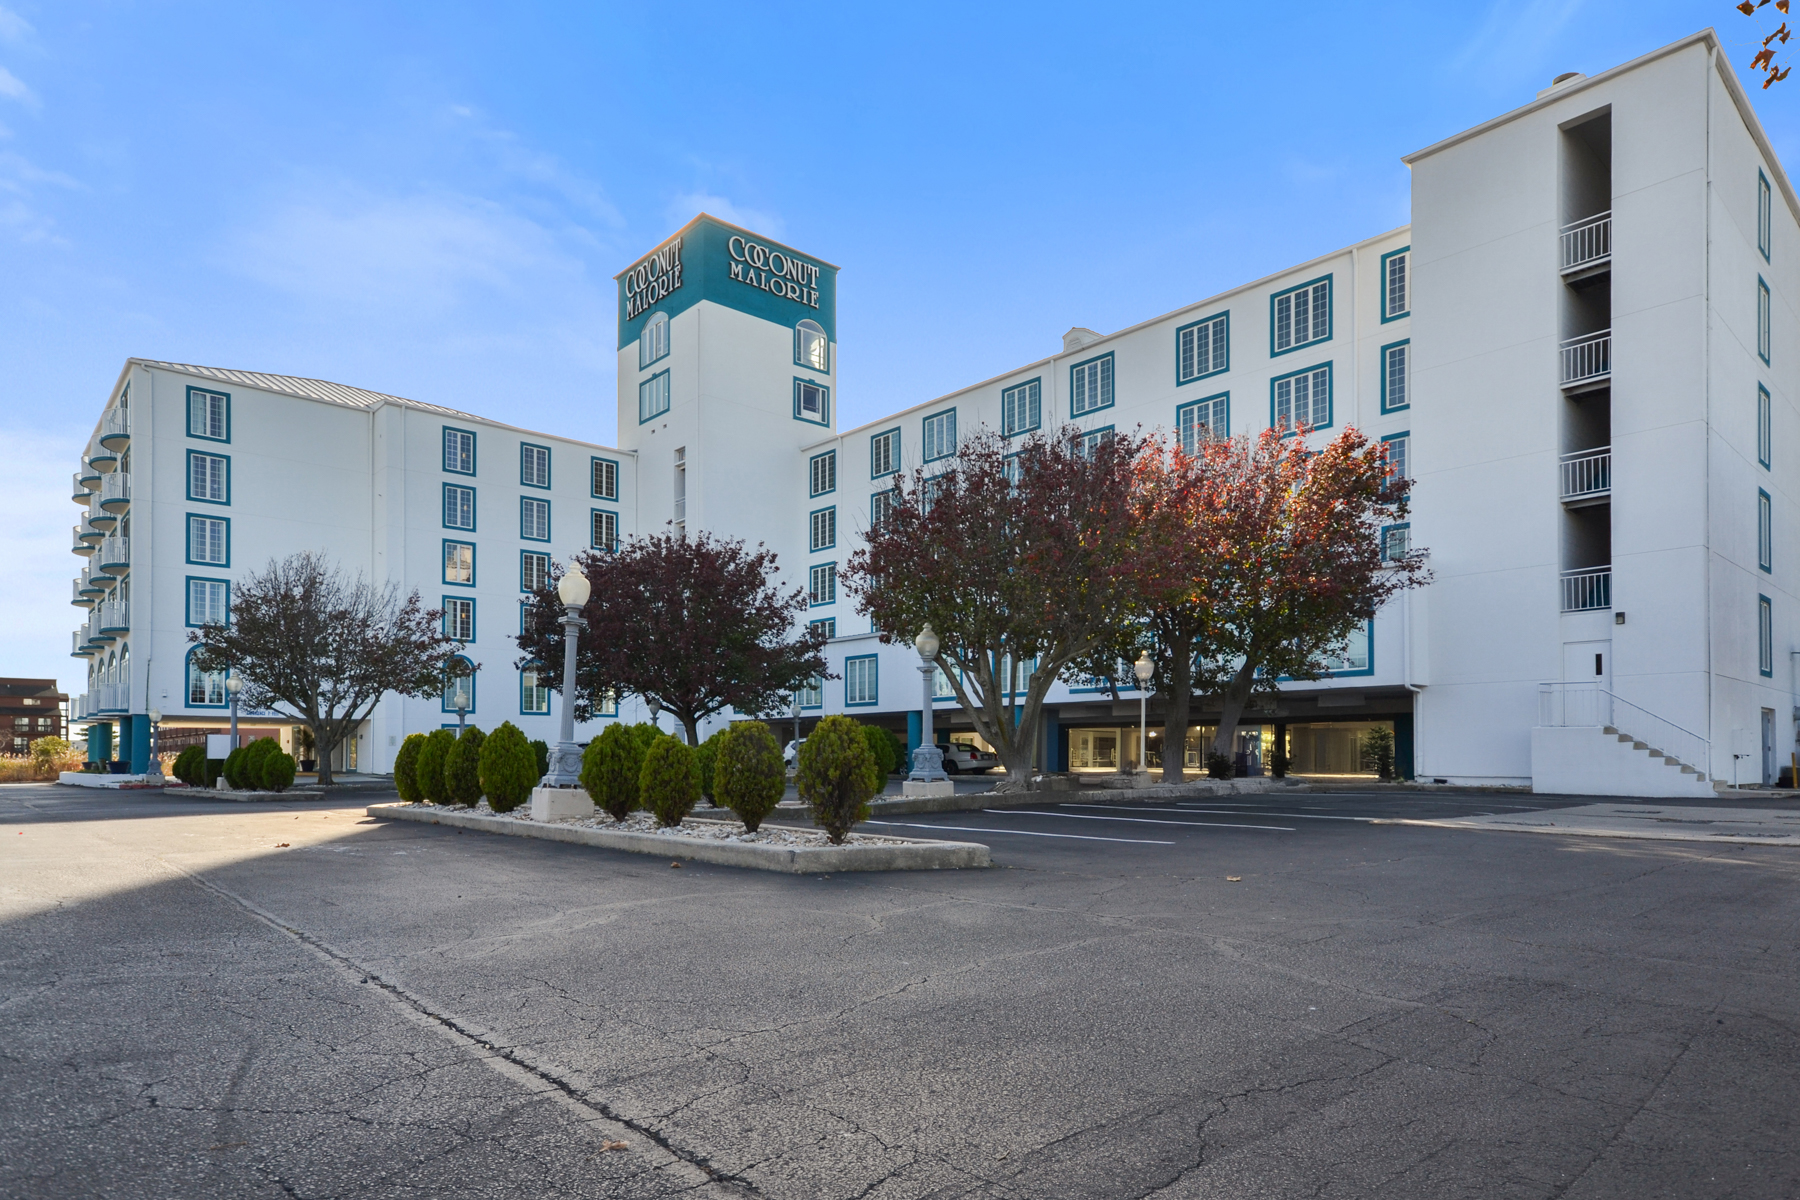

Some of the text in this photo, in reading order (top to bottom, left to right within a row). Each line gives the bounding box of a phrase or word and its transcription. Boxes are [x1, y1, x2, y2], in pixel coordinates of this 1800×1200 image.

[626, 237, 682, 298] COCONUT
[728, 236, 819, 289] COCONUT
[729, 261, 819, 309] MALORIE
[626, 265, 682, 321] MALORIE
